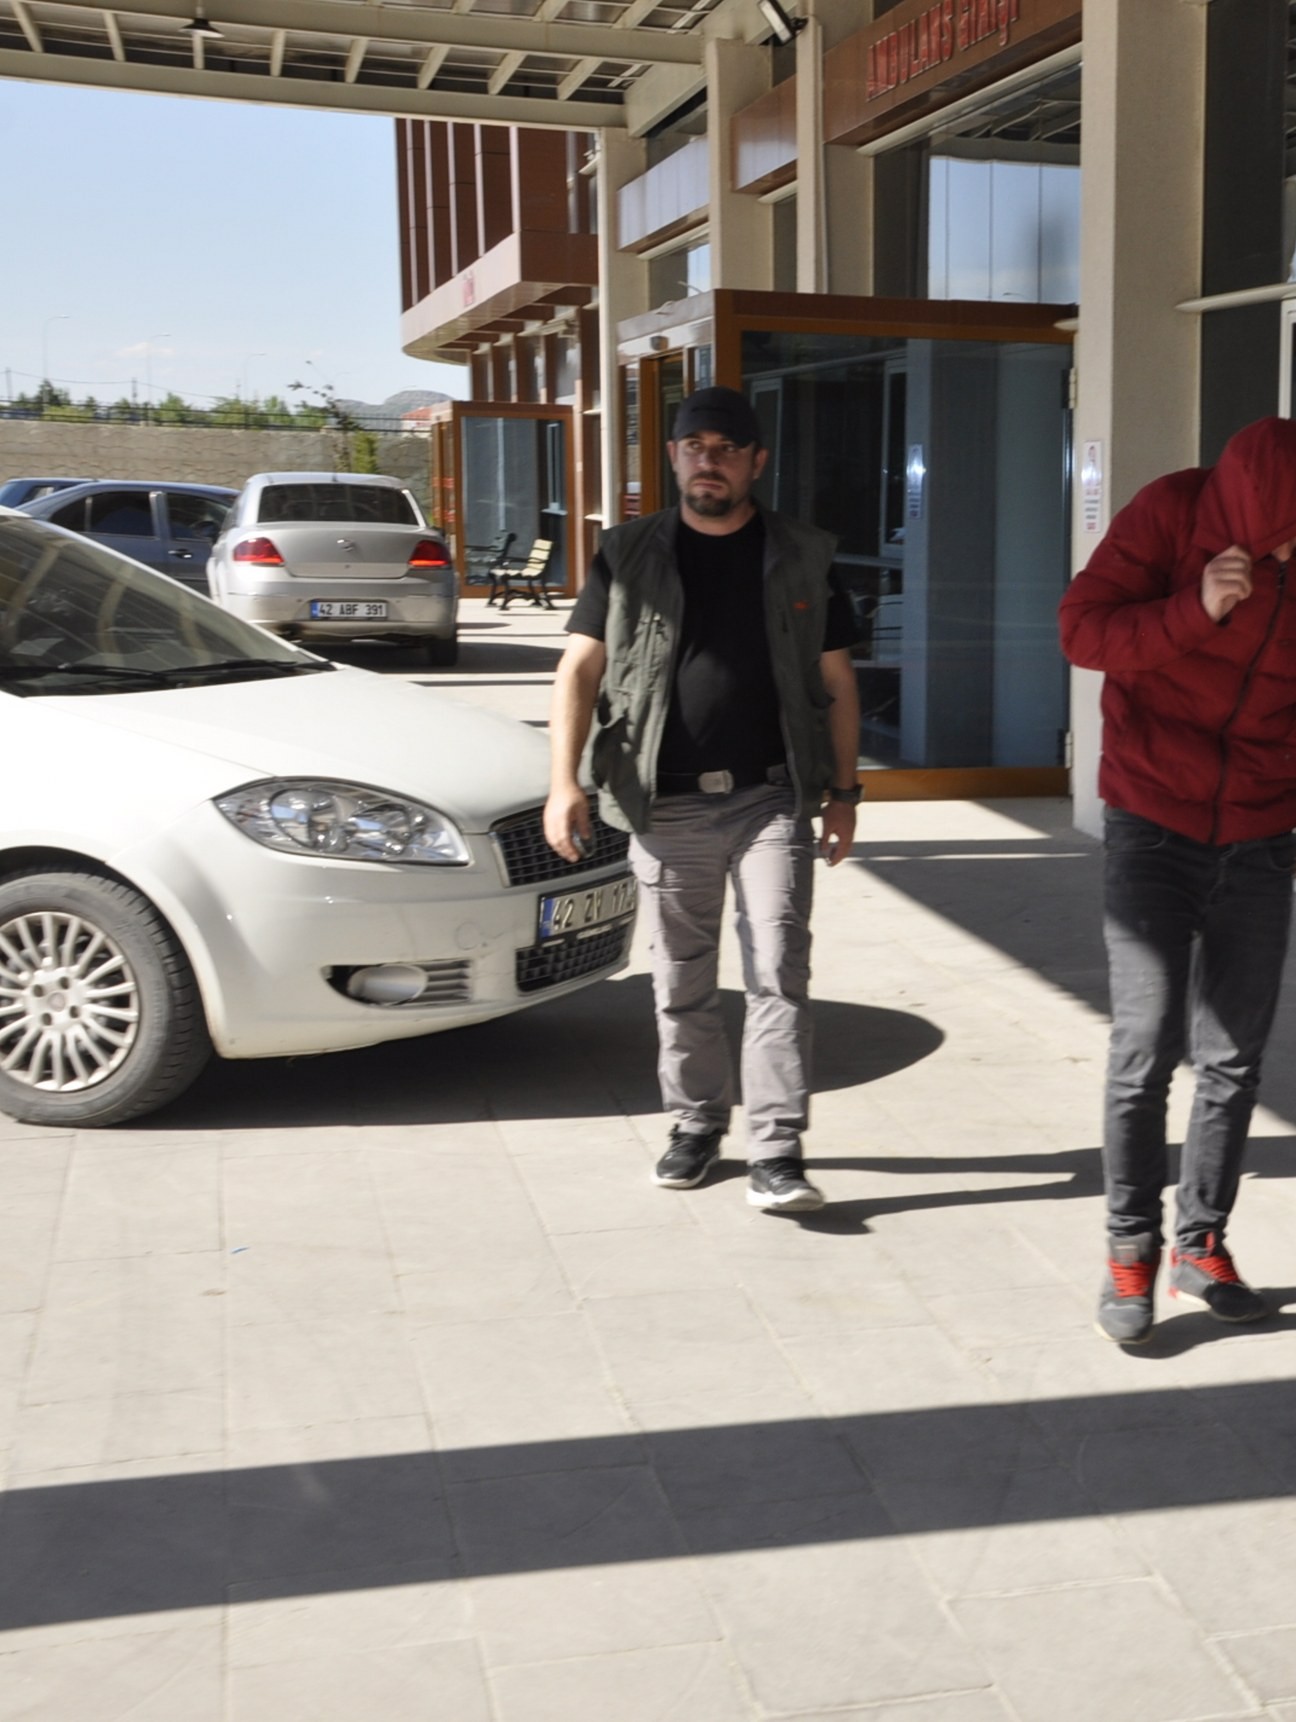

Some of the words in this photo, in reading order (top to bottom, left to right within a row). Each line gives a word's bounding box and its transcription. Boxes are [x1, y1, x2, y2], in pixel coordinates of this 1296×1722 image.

[319, 603, 333, 616] 42
[339, 603, 359, 616] ABF
[552, 898, 574, 931] 42
